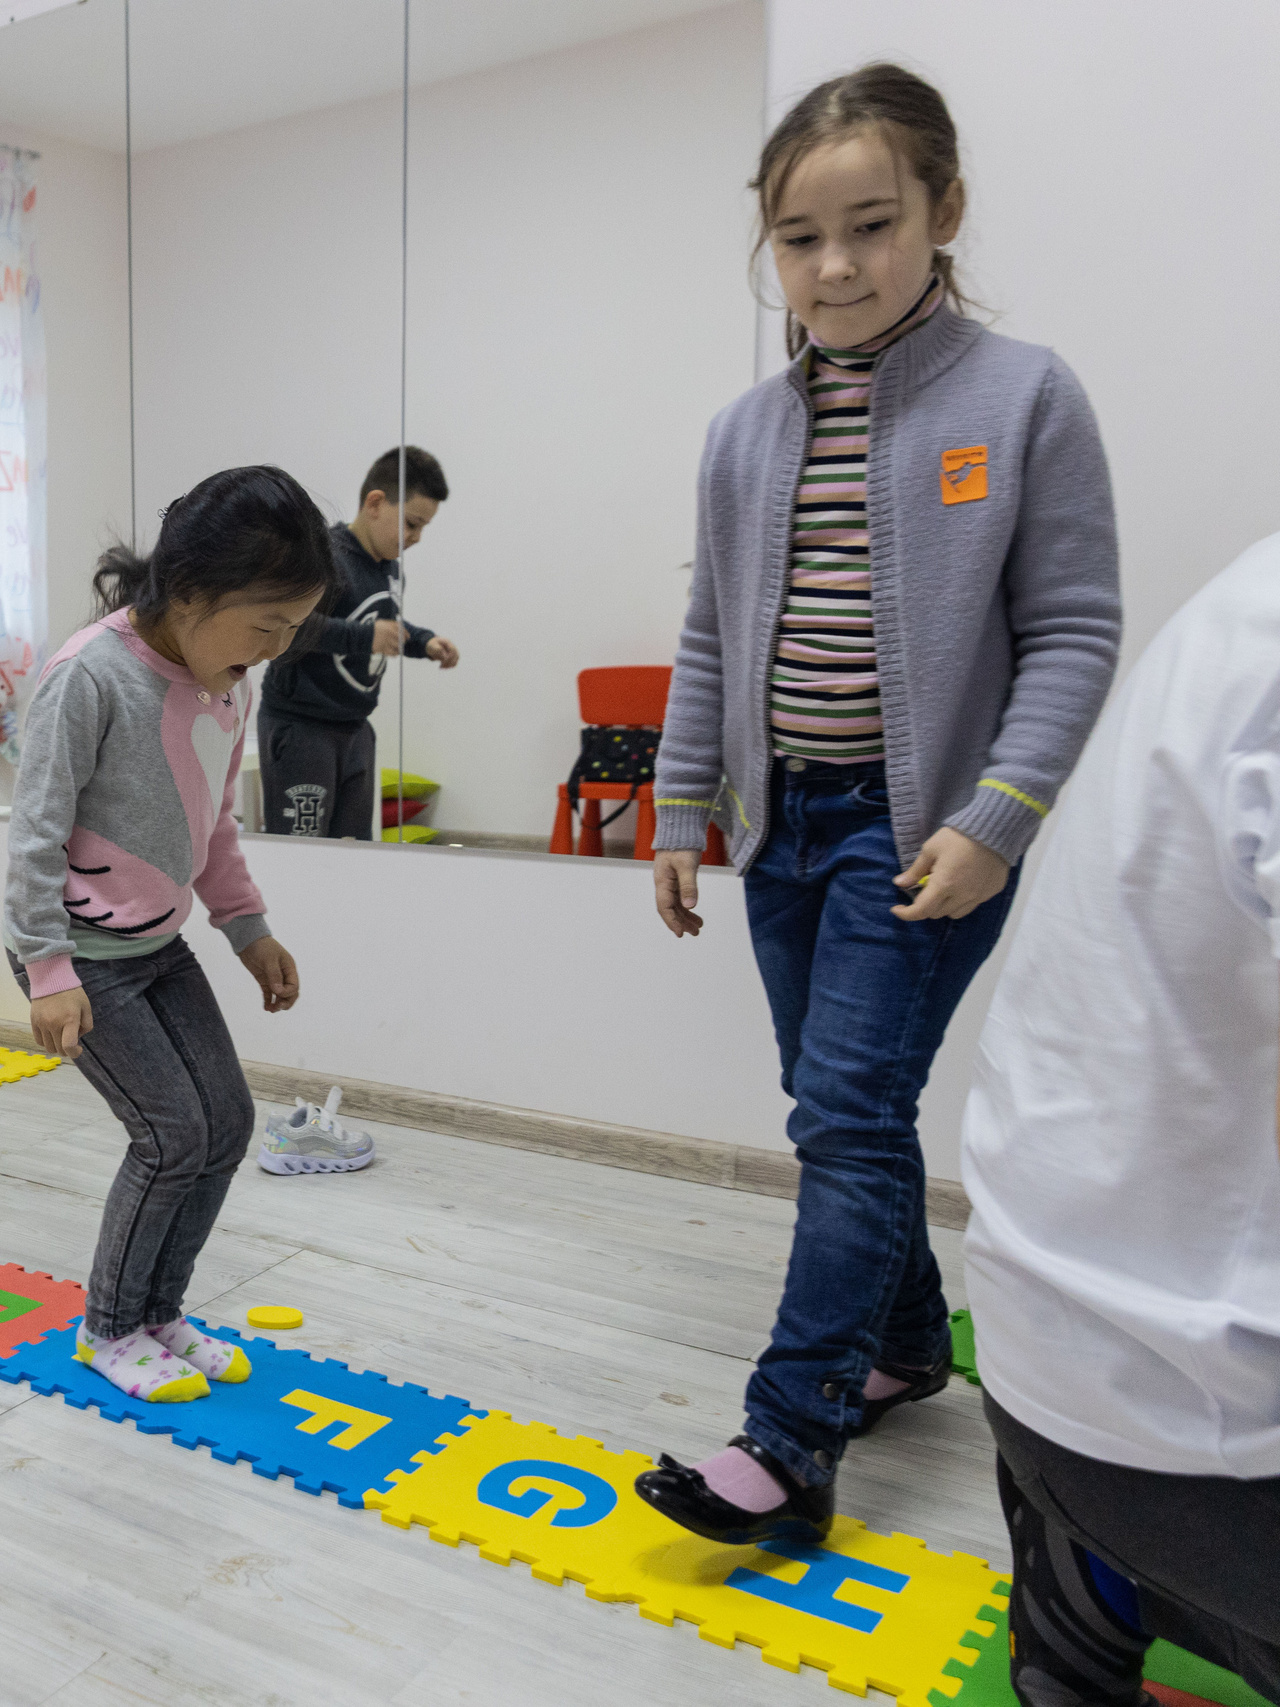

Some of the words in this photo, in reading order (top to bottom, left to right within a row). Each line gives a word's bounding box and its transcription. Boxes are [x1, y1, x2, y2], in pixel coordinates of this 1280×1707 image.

[279, 1388, 394, 1451] F
[477, 1459, 618, 1528] G
[723, 1539, 912, 1635] H
